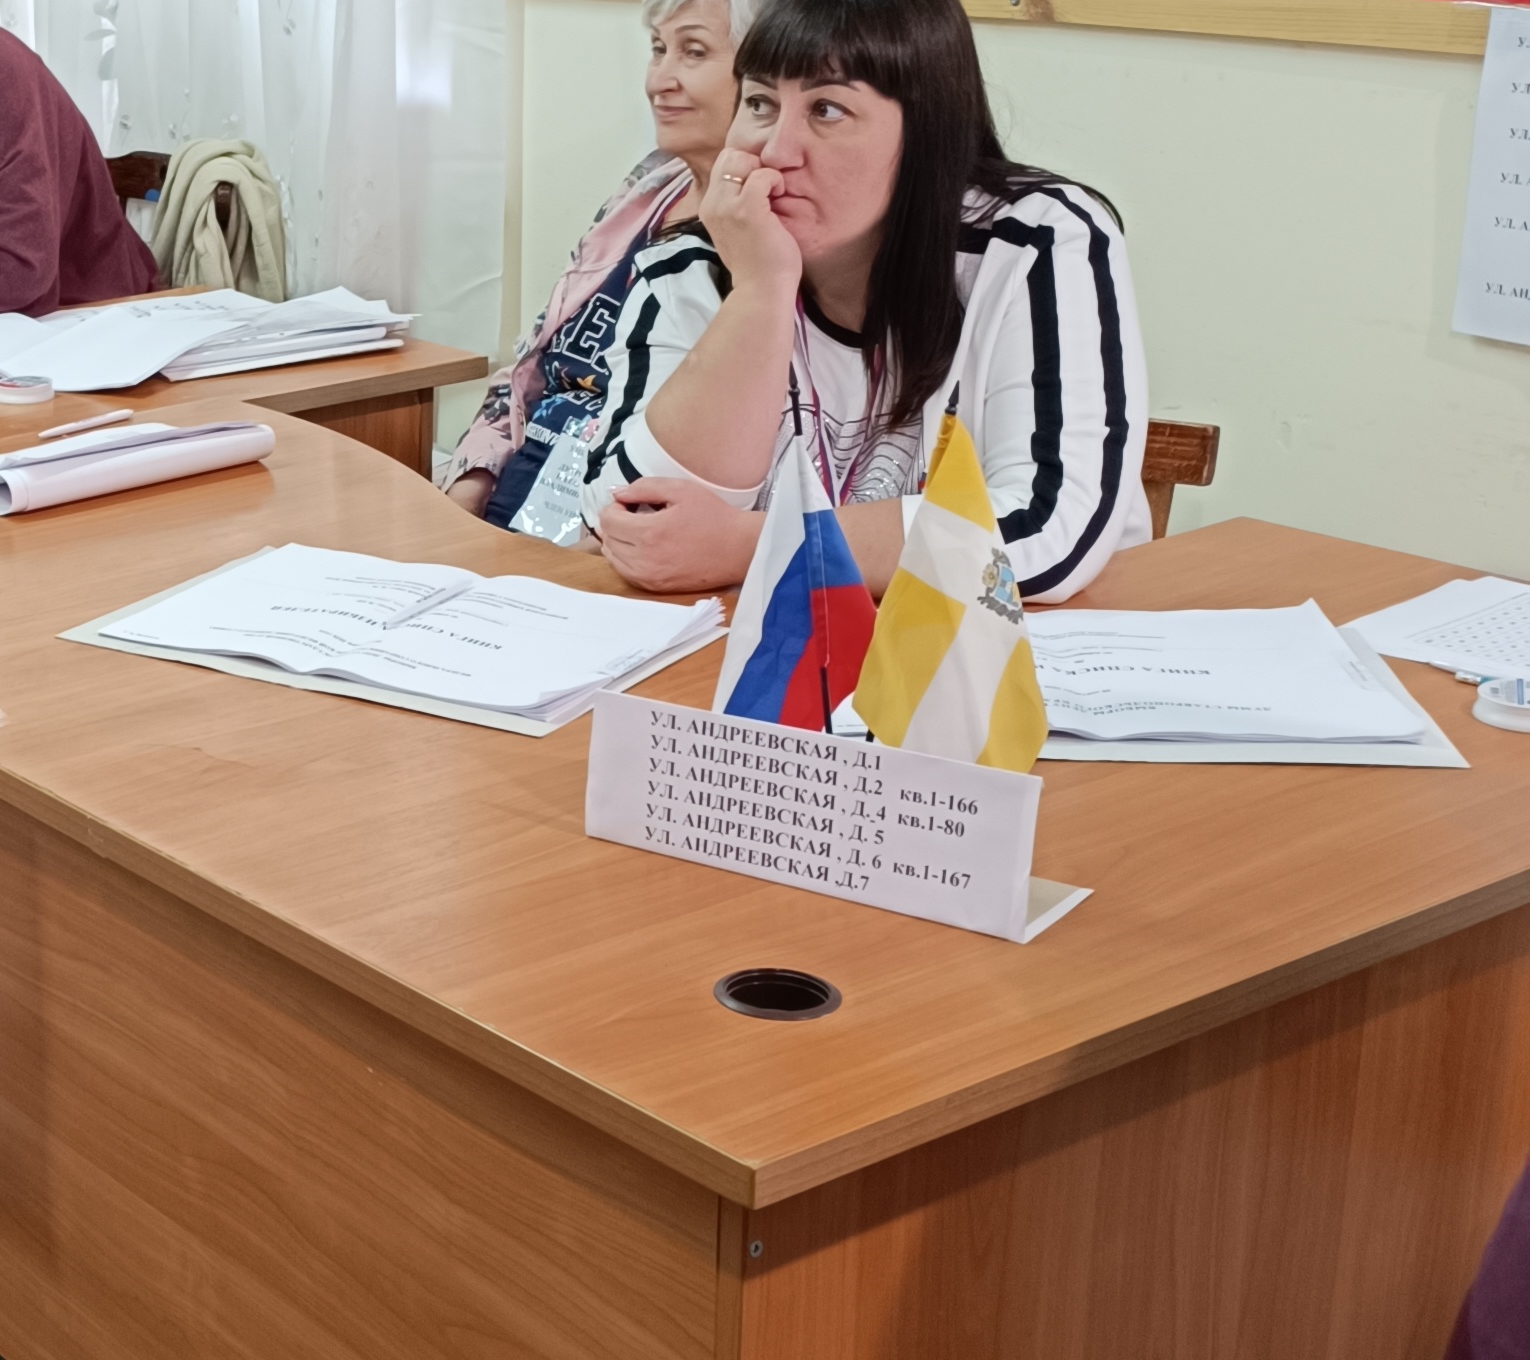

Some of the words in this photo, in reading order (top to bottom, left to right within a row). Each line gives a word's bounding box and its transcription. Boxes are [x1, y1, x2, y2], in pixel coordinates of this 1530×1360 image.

[650, 710, 682, 731] УЛ.
[852, 751, 882, 771] Д.1
[650, 734, 682, 755] УЛ.
[852, 776, 883, 795] Д.2
[900, 789, 979, 815] кв.1-166
[648, 780, 679, 801] УЛ.
[649, 757, 680, 778] УЛ.
[897, 813, 966, 838] кв.1-80
[644, 826, 676, 846] УЛ.
[680, 836, 830, 882] АНДРЕЕВСКАЯ
[646, 803, 677, 824] УЛ.
[893, 862, 972, 889] кв.1-167
